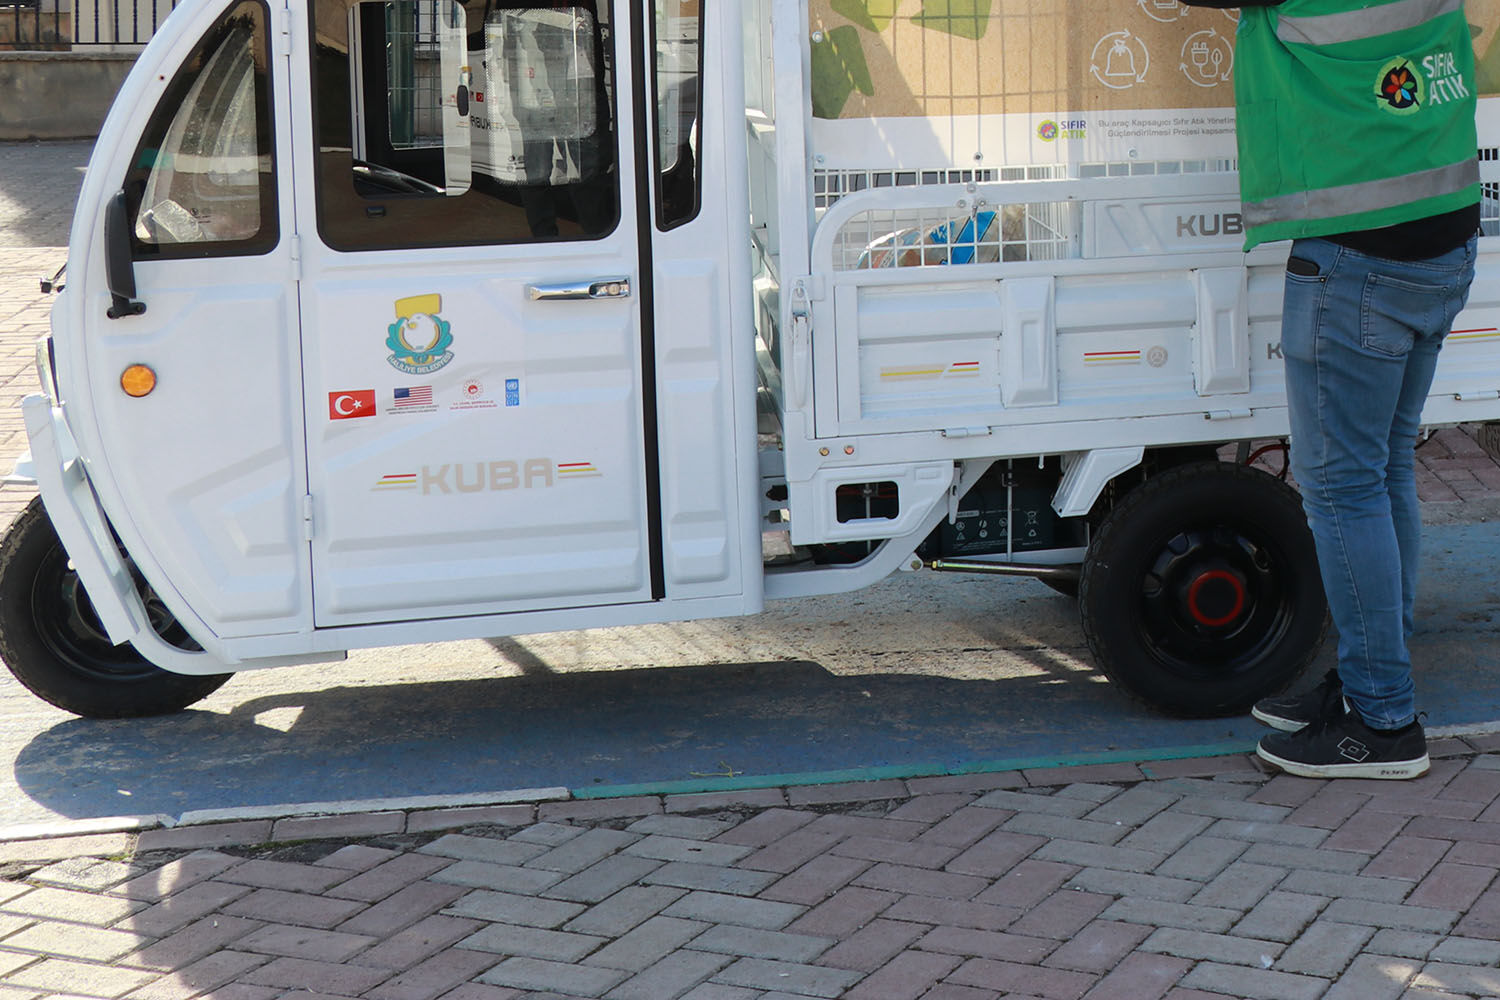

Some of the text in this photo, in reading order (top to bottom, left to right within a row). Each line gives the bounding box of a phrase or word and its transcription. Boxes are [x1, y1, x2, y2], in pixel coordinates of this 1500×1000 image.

[1422, 51, 1458, 79] SIFIR
[1429, 73, 1470, 107] ATIK
[1060, 120, 1087, 130] SIFIR
[1060, 130, 1087, 140] ATIK
[1098, 120, 1110, 128] Bu
[1176, 212, 1243, 238] KUB
[421, 457, 554, 497] KUBA
